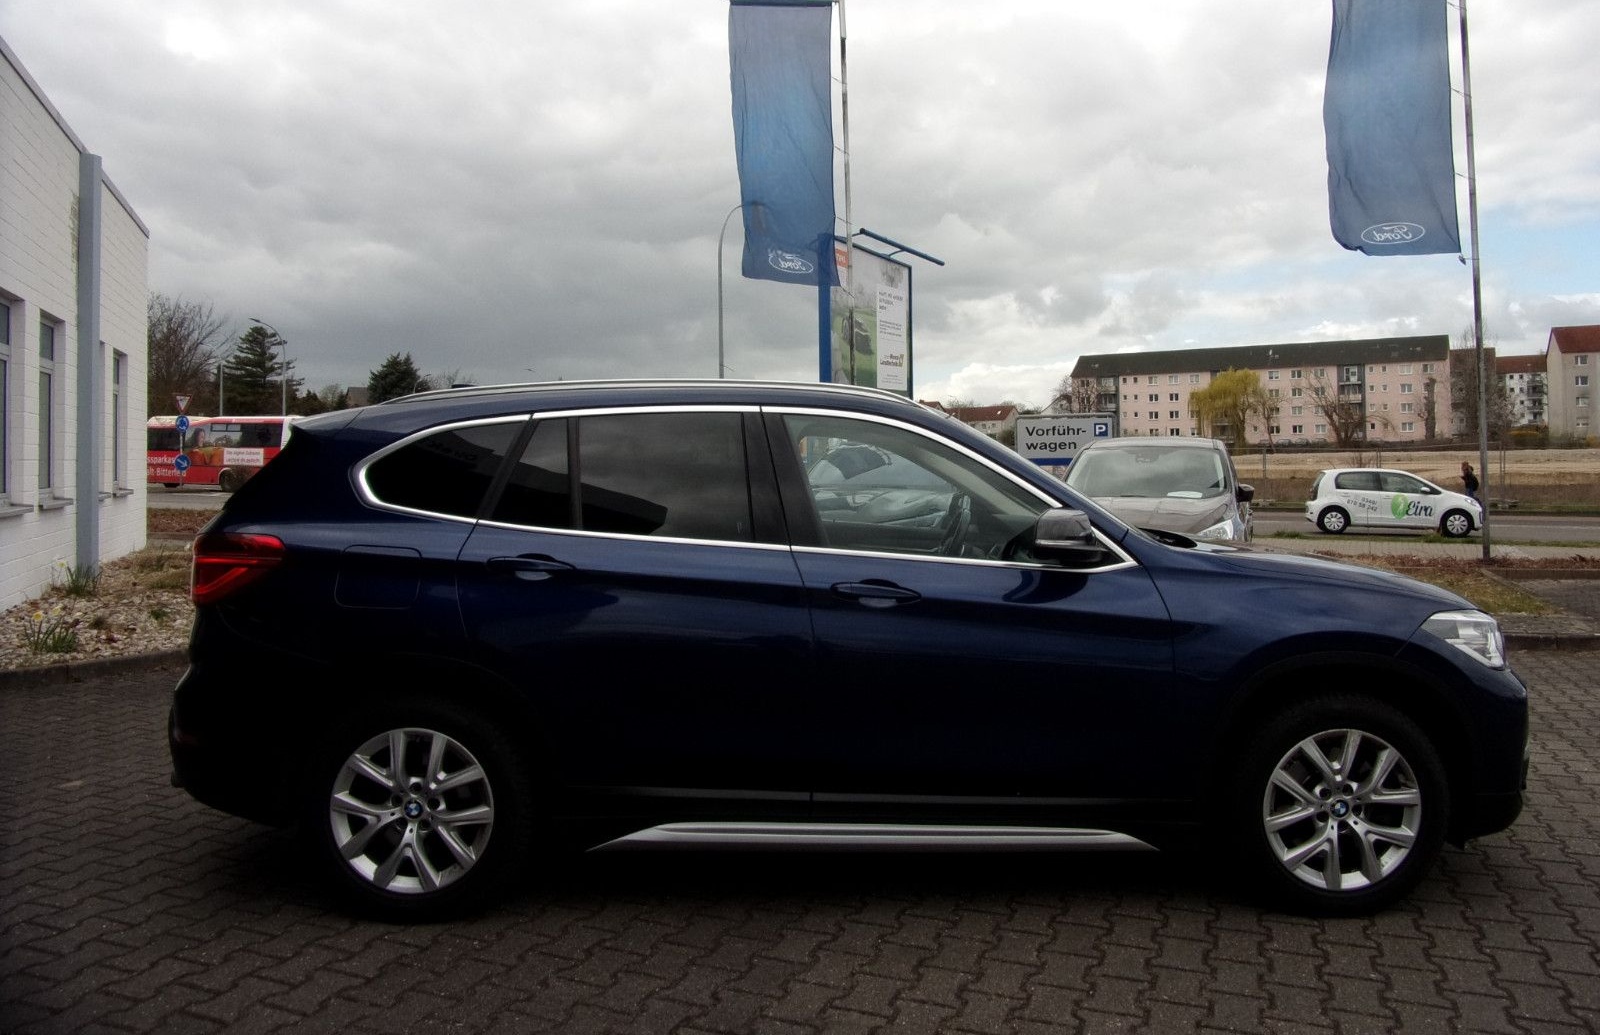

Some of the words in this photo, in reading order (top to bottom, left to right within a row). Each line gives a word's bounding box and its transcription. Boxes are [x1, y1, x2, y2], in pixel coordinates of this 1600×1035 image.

[1026, 425, 1087, 437] Vorführ-
[1026, 441, 1077, 452] wagen
[147, 455, 176, 465] ssparkas
[1406, 501, 1433, 517] Eira
